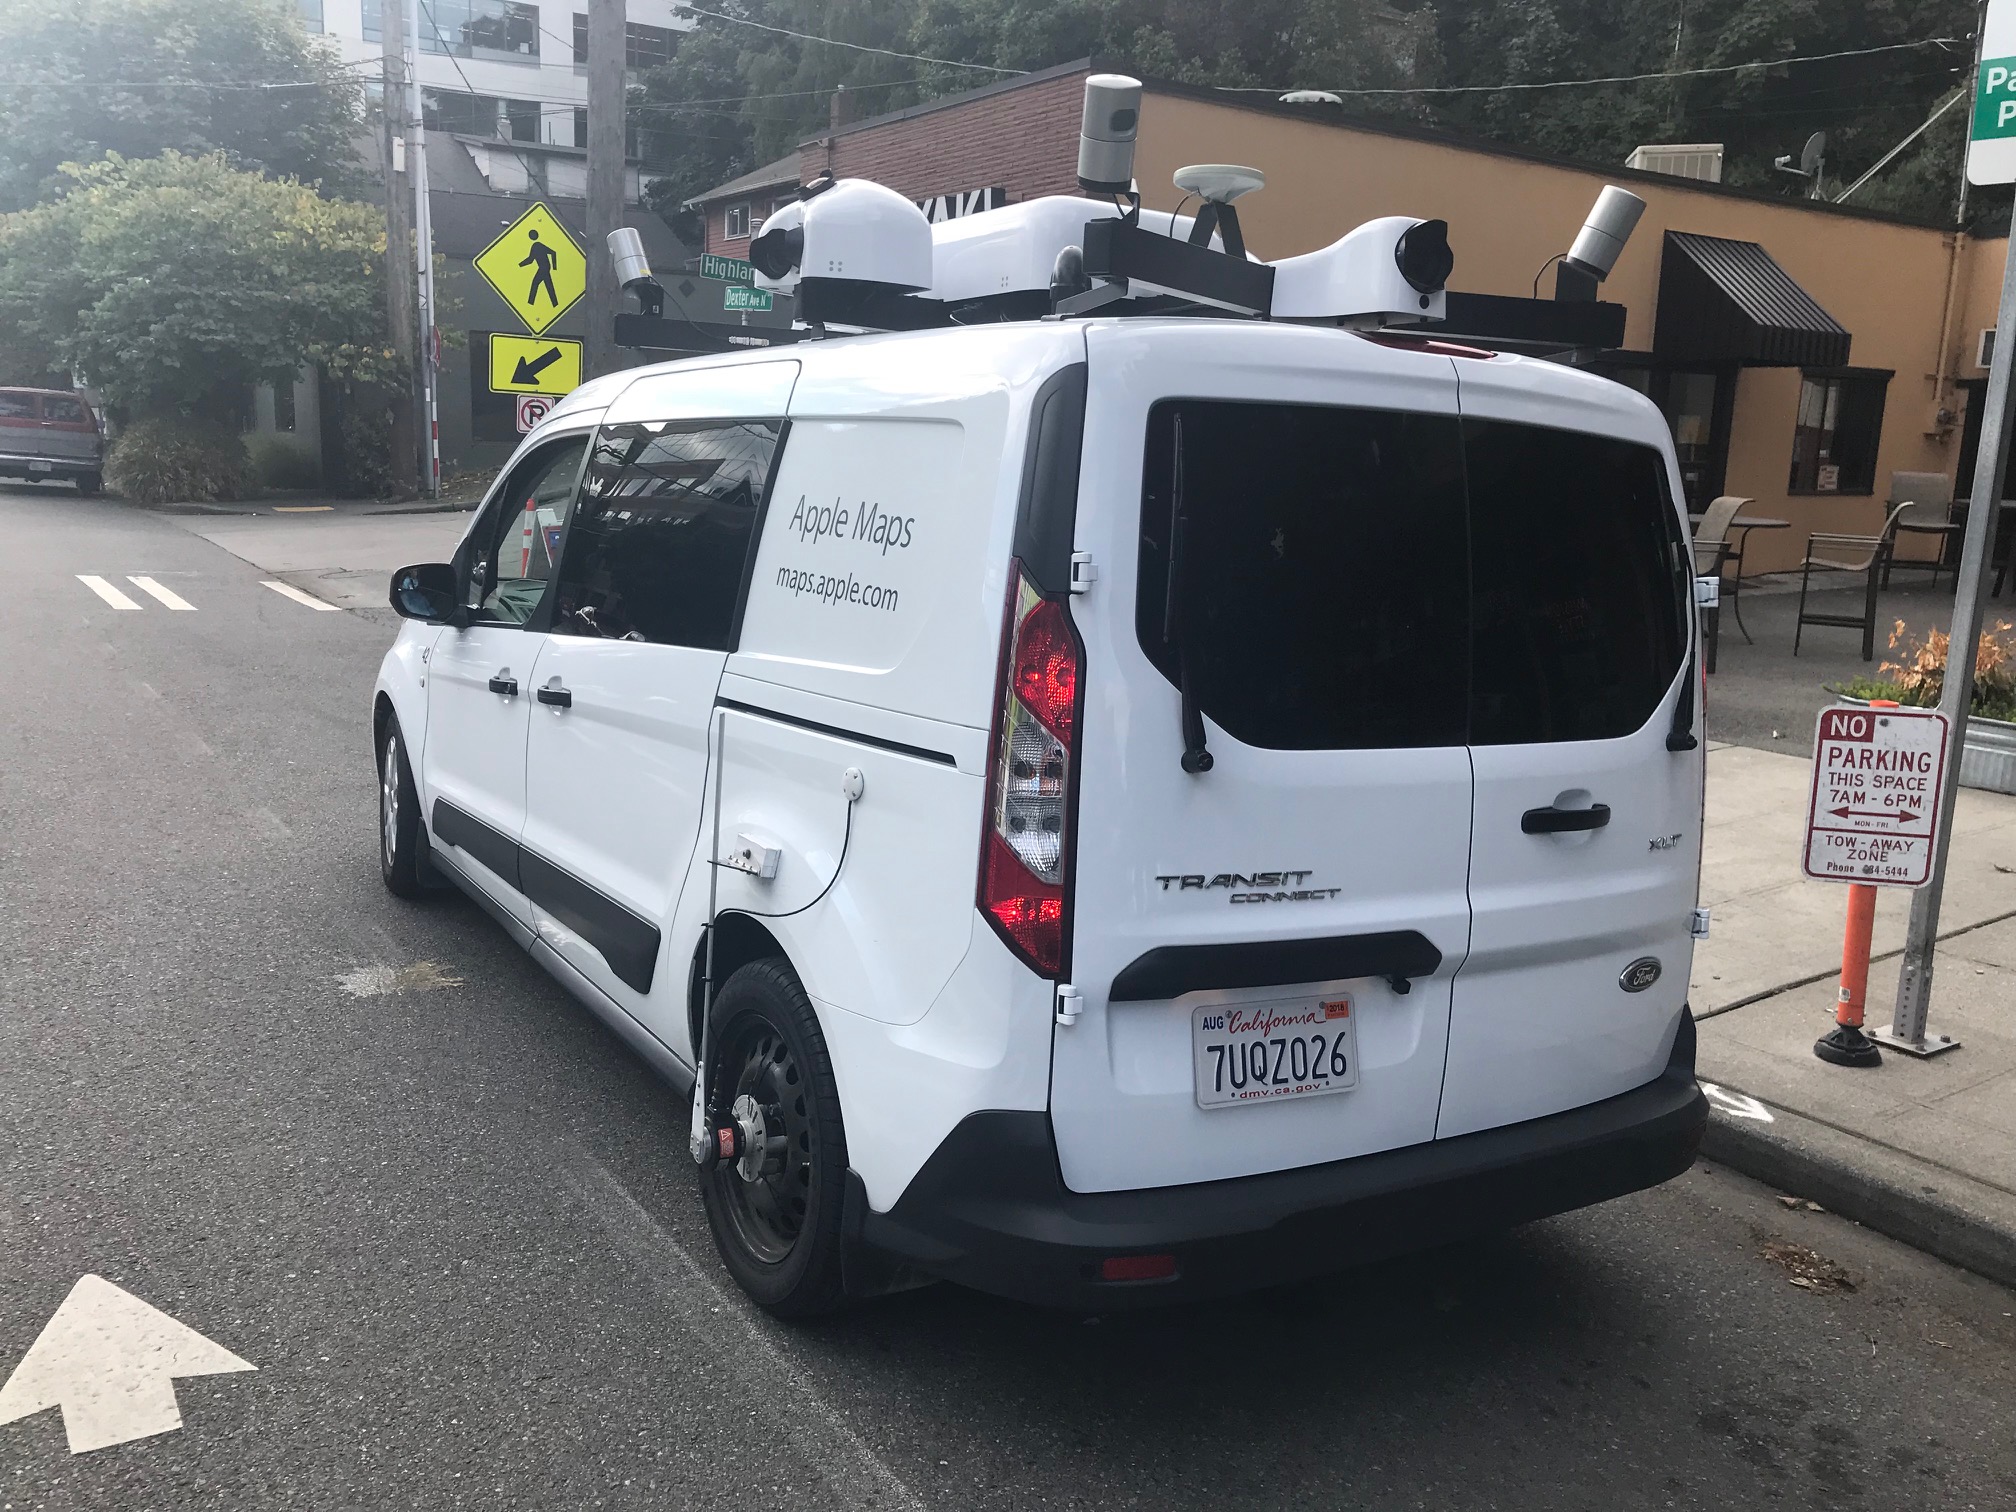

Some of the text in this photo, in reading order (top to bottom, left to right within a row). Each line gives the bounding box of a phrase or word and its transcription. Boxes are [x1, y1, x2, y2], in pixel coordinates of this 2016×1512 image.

[726, 288, 766, 306] Dexter Ave N
[788, 494, 915, 556] Apple Maps
[776, 566, 899, 612] maps.apple.com
[1830, 714, 1867, 738] NO
[1827, 746, 1932, 773] PARKING
[1828, 772, 1928, 791] THIS SPACE
[1829, 789, 1866, 805] 7AM
[1883, 794, 1922, 808] 6PM
[1648, 833, 1682, 851] XLT
[1847, 849, 1889, 863] ZONE
[1827, 861, 1908, 877] Phone 84-5444
[1155, 870, 1313, 890] TRANSIT
[1229, 888, 1342, 904] CONNECT
[1633, 967, 1657, 985] Ford
[1202, 1015, 1224, 1031] AUG
[1228, 1005, 1326, 1038] California
[1206, 1031, 1348, 1093] 7UQZ026
[1239, 1082, 1321, 1099] dmv.ca.gov
